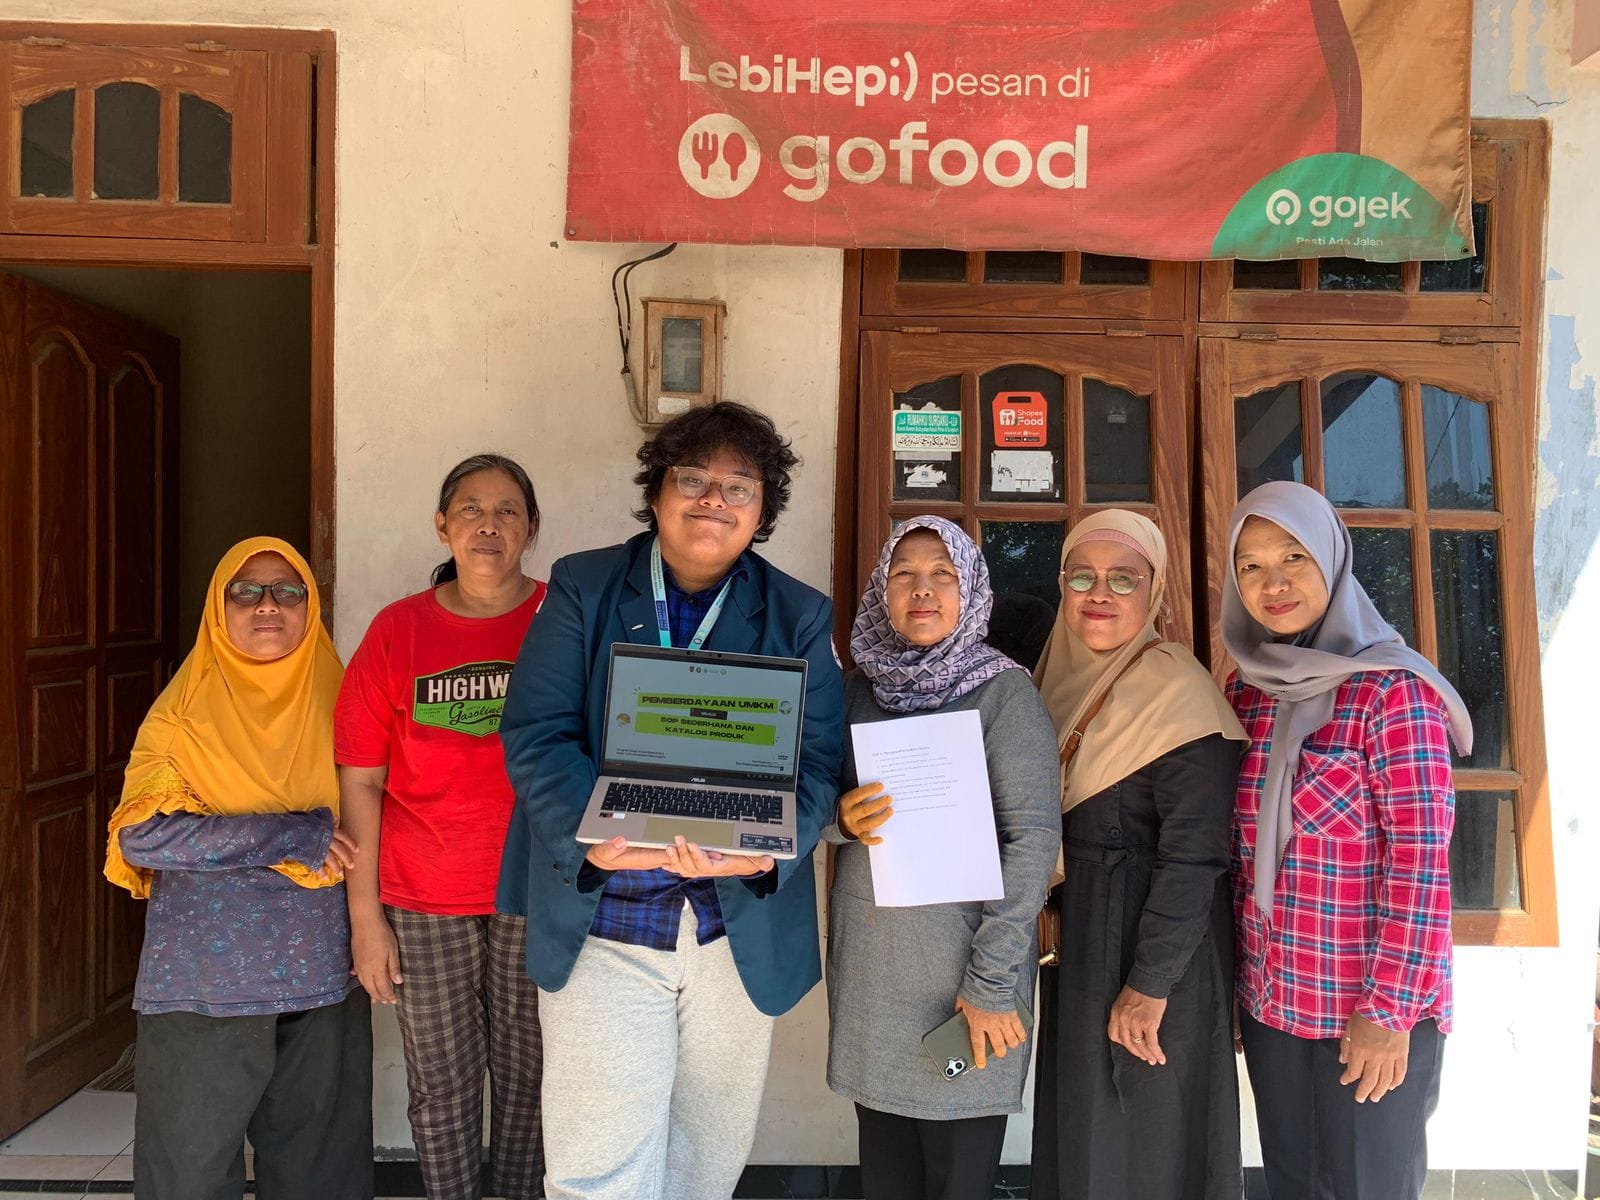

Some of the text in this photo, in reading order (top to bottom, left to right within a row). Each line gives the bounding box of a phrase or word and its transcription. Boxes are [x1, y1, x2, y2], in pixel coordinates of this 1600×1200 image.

[931, 72, 1047, 104] pesan
[1057, 67, 1090, 98] di
[778, 121, 1089, 202] gofood
[1309, 192, 1413, 228] gojek
[1296, 236, 1384, 247] Pasti Ada Jalan
[1017, 410, 1043, 418] Shopee
[1017, 416, 1044, 426] Food
[641, 696, 774, 710] PEMBERDAYAAN UMKM
[680, 718, 733, 730] SEDERHANA
[735, 724, 755, 732] DAN
[665, 726, 745, 740] KATALOG PRODUK
